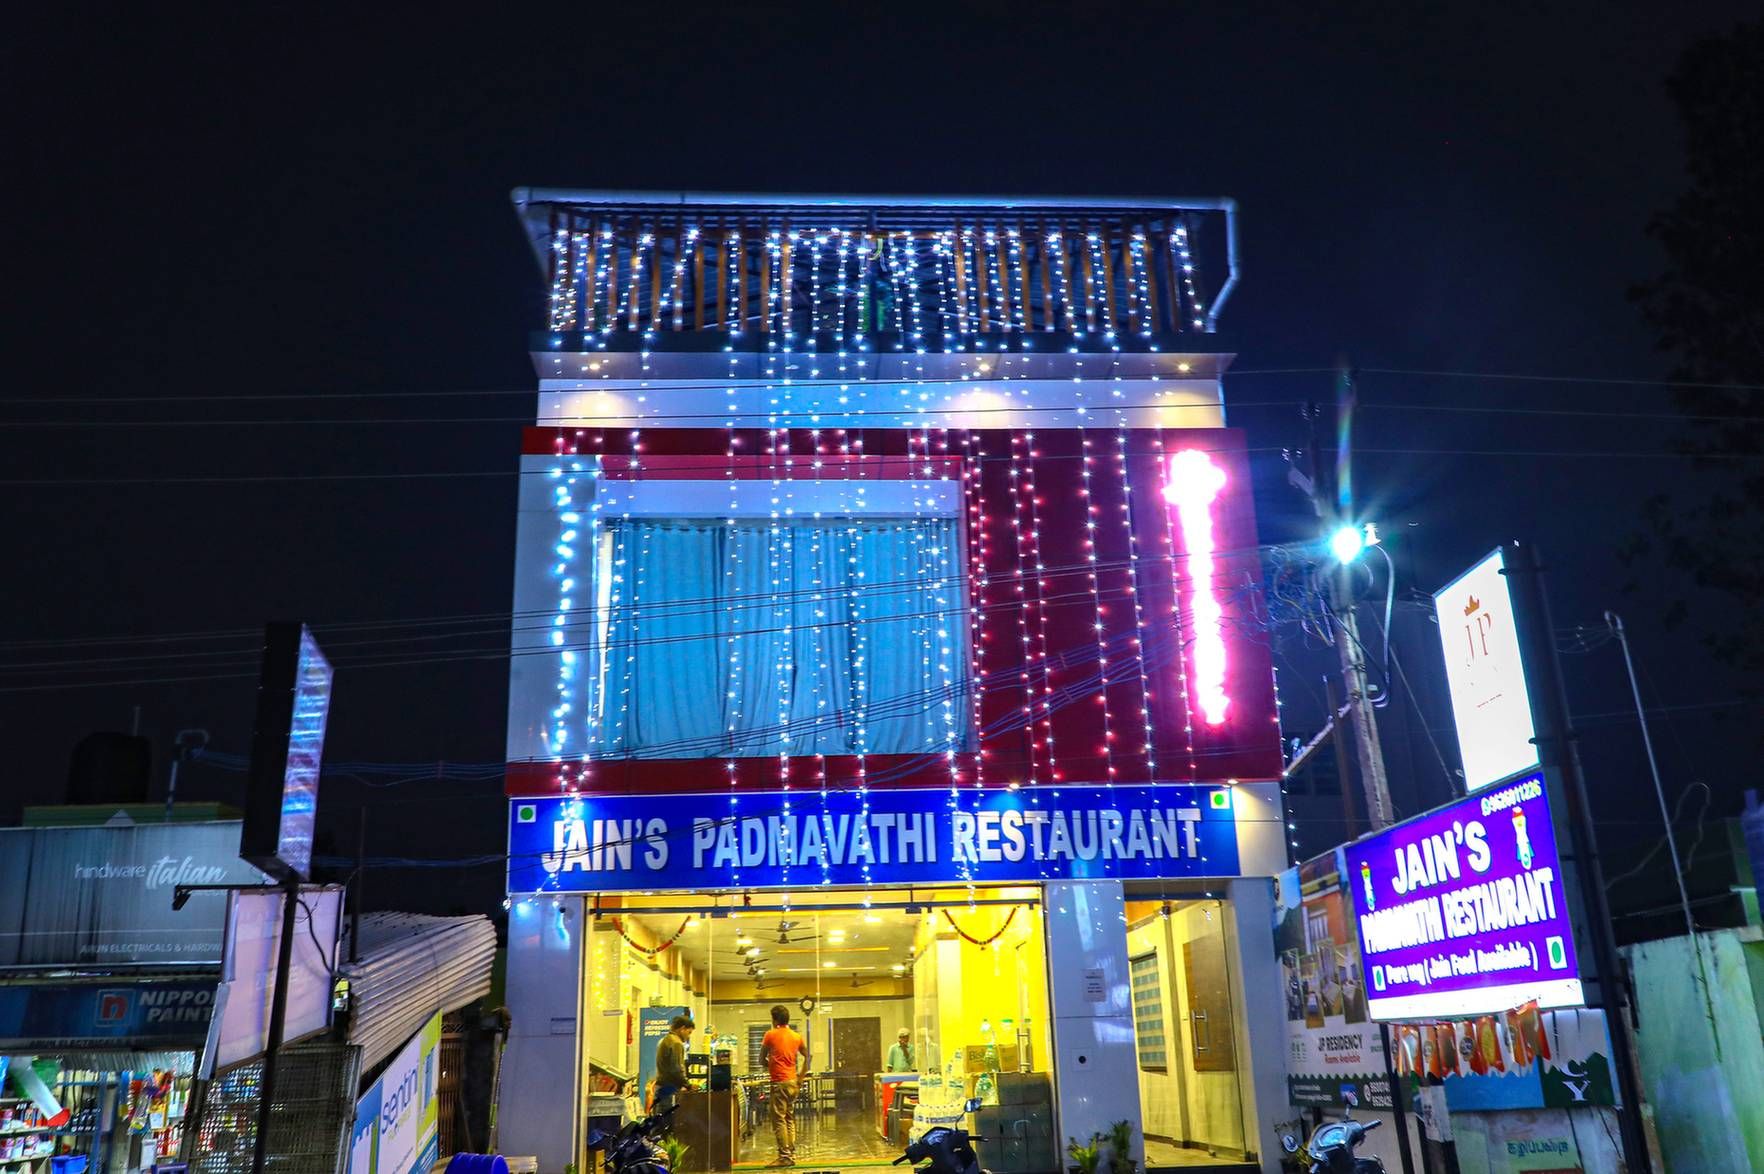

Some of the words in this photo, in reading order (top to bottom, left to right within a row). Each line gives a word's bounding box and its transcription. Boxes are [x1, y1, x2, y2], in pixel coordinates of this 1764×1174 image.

[541, 818, 669, 872] JAIN'S
[693, 813, 937, 869] PADMAVATHI
[952, 807, 1201, 863] RESTAURANT
[1391, 821, 1492, 895] JAIN'S
[74, 861, 147, 879] hindware
[146, 855, 229, 890] italian
[1441, 866, 1557, 938] RESTAURANT
[110, 943, 173, 953] ELECTRICALS
[1326, 1033, 1363, 1051] RESIDENCY
